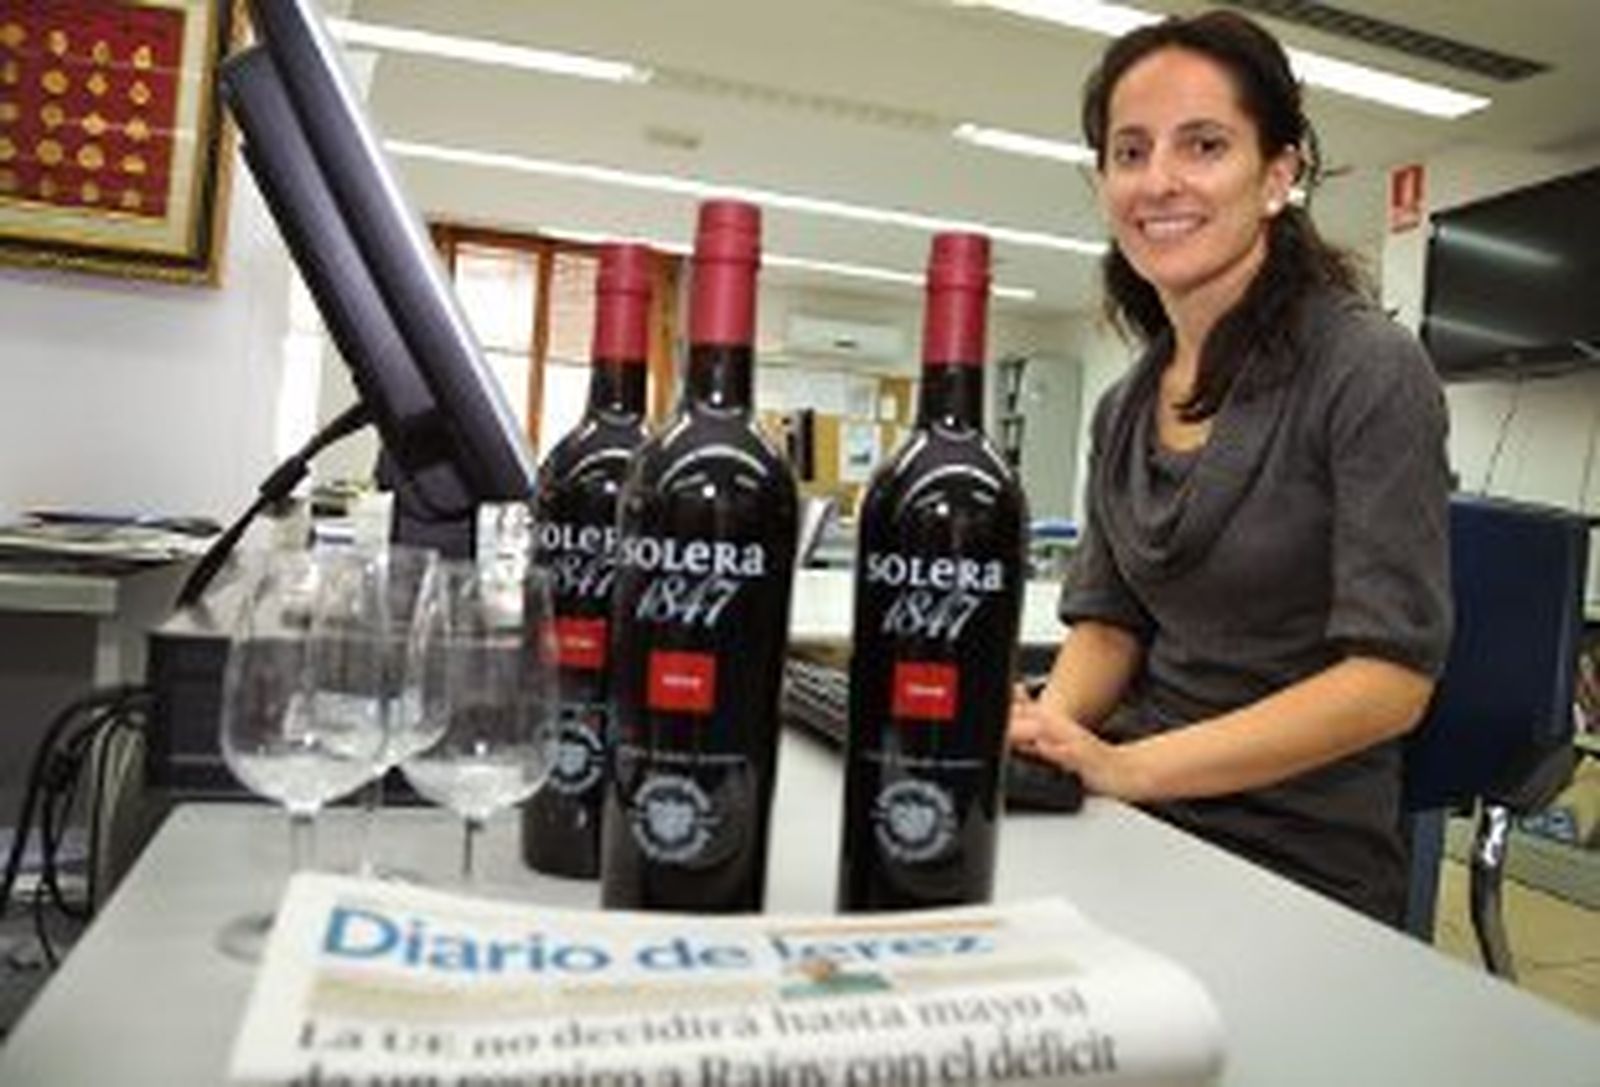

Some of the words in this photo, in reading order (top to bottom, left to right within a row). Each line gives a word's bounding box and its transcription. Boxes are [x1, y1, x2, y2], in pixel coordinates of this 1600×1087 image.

[635, 574, 740, 627] 1847
[882, 588, 979, 639] 1847
[323, 906, 611, 972] Diario
[636, 937, 752, 970] de
[472, 1034, 539, 1057] no
[772, 1002, 906, 1036] hasta
[919, 993, 1042, 1027] mayo
[844, 1051, 928, 1087] con
[938, 1034, 977, 1086] el
